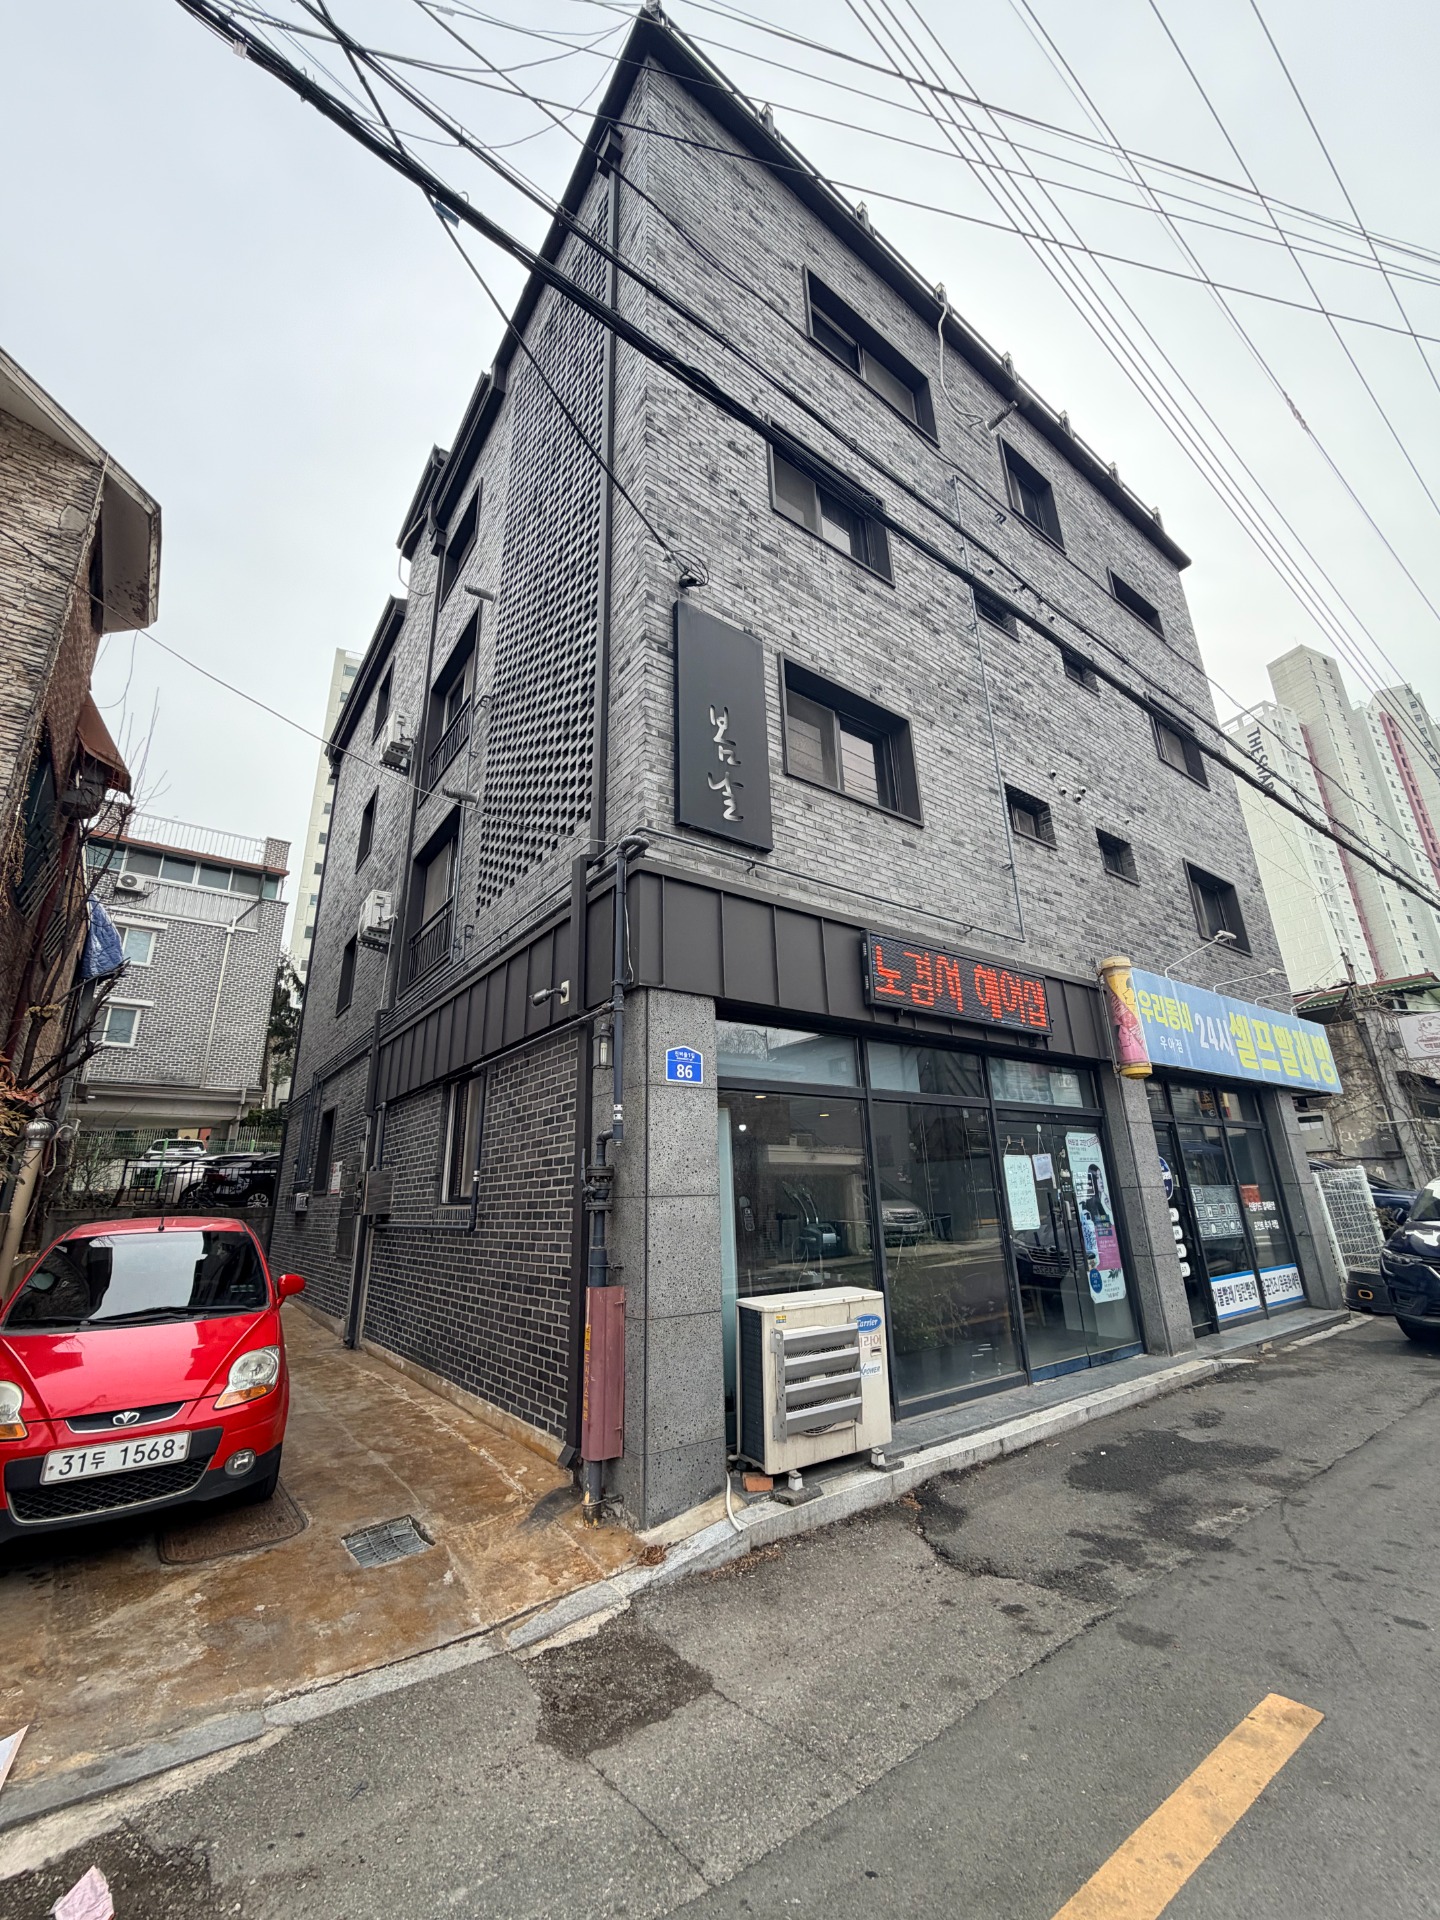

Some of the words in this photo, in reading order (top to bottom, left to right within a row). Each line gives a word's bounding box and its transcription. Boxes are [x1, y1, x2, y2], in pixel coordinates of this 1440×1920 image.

[1246, 726, 1264, 757] THE
[1136, 988, 1195, 1034] 우리동네
[1194, 1012, 1235, 1057] 24시
[1228, 1010, 1337, 1085] 셀프빨래방
[1159, 1035, 1184, 1054] 우아점
[676, 1064, 693, 1079] 86
[58, 1451, 106, 1477] 31두
[119, 1438, 175, 1467] 1568
